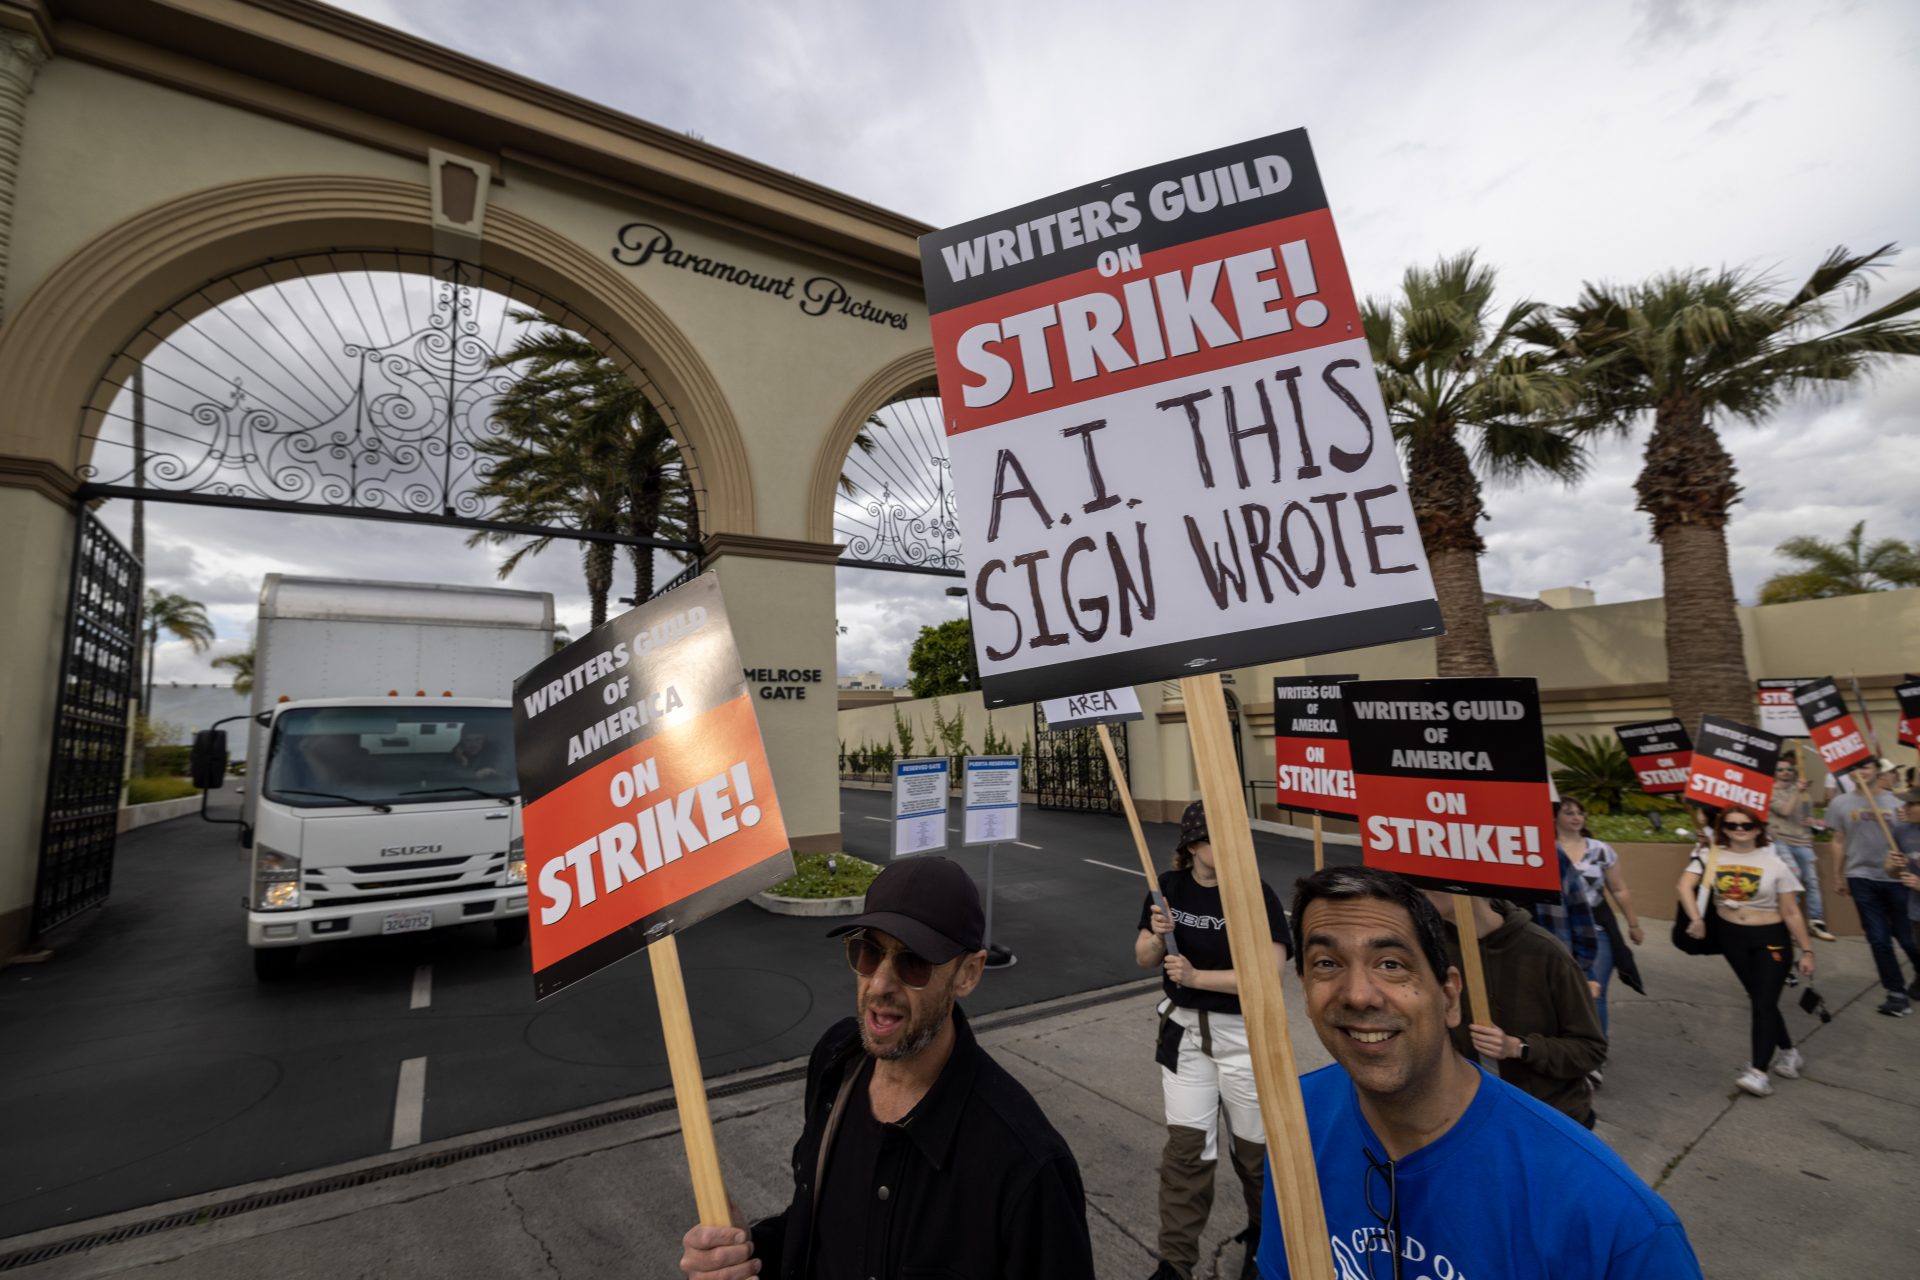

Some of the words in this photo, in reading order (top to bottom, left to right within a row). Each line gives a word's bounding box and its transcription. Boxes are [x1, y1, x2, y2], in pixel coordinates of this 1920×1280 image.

[941, 192, 1141, 283] WRITERS
[1149, 155, 1292, 222] GUILD
[1097, 243, 1142, 277] ON
[612, 223, 795, 300] Paramount
[799, 277, 908, 331] Pictures
[955, 239, 1330, 408] STRIKE!
[987, 419, 1143, 543] A.I.
[1156, 358, 1374, 490] THIS
[975, 521, 1156, 662] SIGN
[1184, 485, 1418, 610] WROTE
[523, 642, 629, 719] WRITERS
[633, 606, 708, 657] GUILD
[743, 668, 822, 682] MELROSE
[603, 675, 630, 705] OF
[760, 686, 806, 700] GATE
[1069, 690, 1118, 717] AREA
[1277, 686, 1320, 699] WRITERS
[1321, 685, 1342, 699] GUI
[1307, 704, 1319, 715] OF
[1353, 701, 1449, 720] WRITERS
[1453, 700, 1525, 720] GUILD
[567, 685, 683, 766] AMERICA
[1292, 719, 1338, 733] AMERICA
[1424, 728, 1448, 743] OF
[1306, 746, 1325, 763] ON
[1392, 749, 1494, 771] AMERICA
[610, 757, 661, 808] ON
[1279, 764, 1357, 799] STRIKE!
[1639, 767, 1692, 785] STRIK
[1724, 769, 1744, 783] ON
[1426, 791, 1467, 815] ON
[1691, 773, 1767, 811] STRIKE!
[380, 844, 442, 857] ISUZU
[538, 761, 761, 926] STRIKE!
[1367, 815, 1544, 868] STRIKE!
